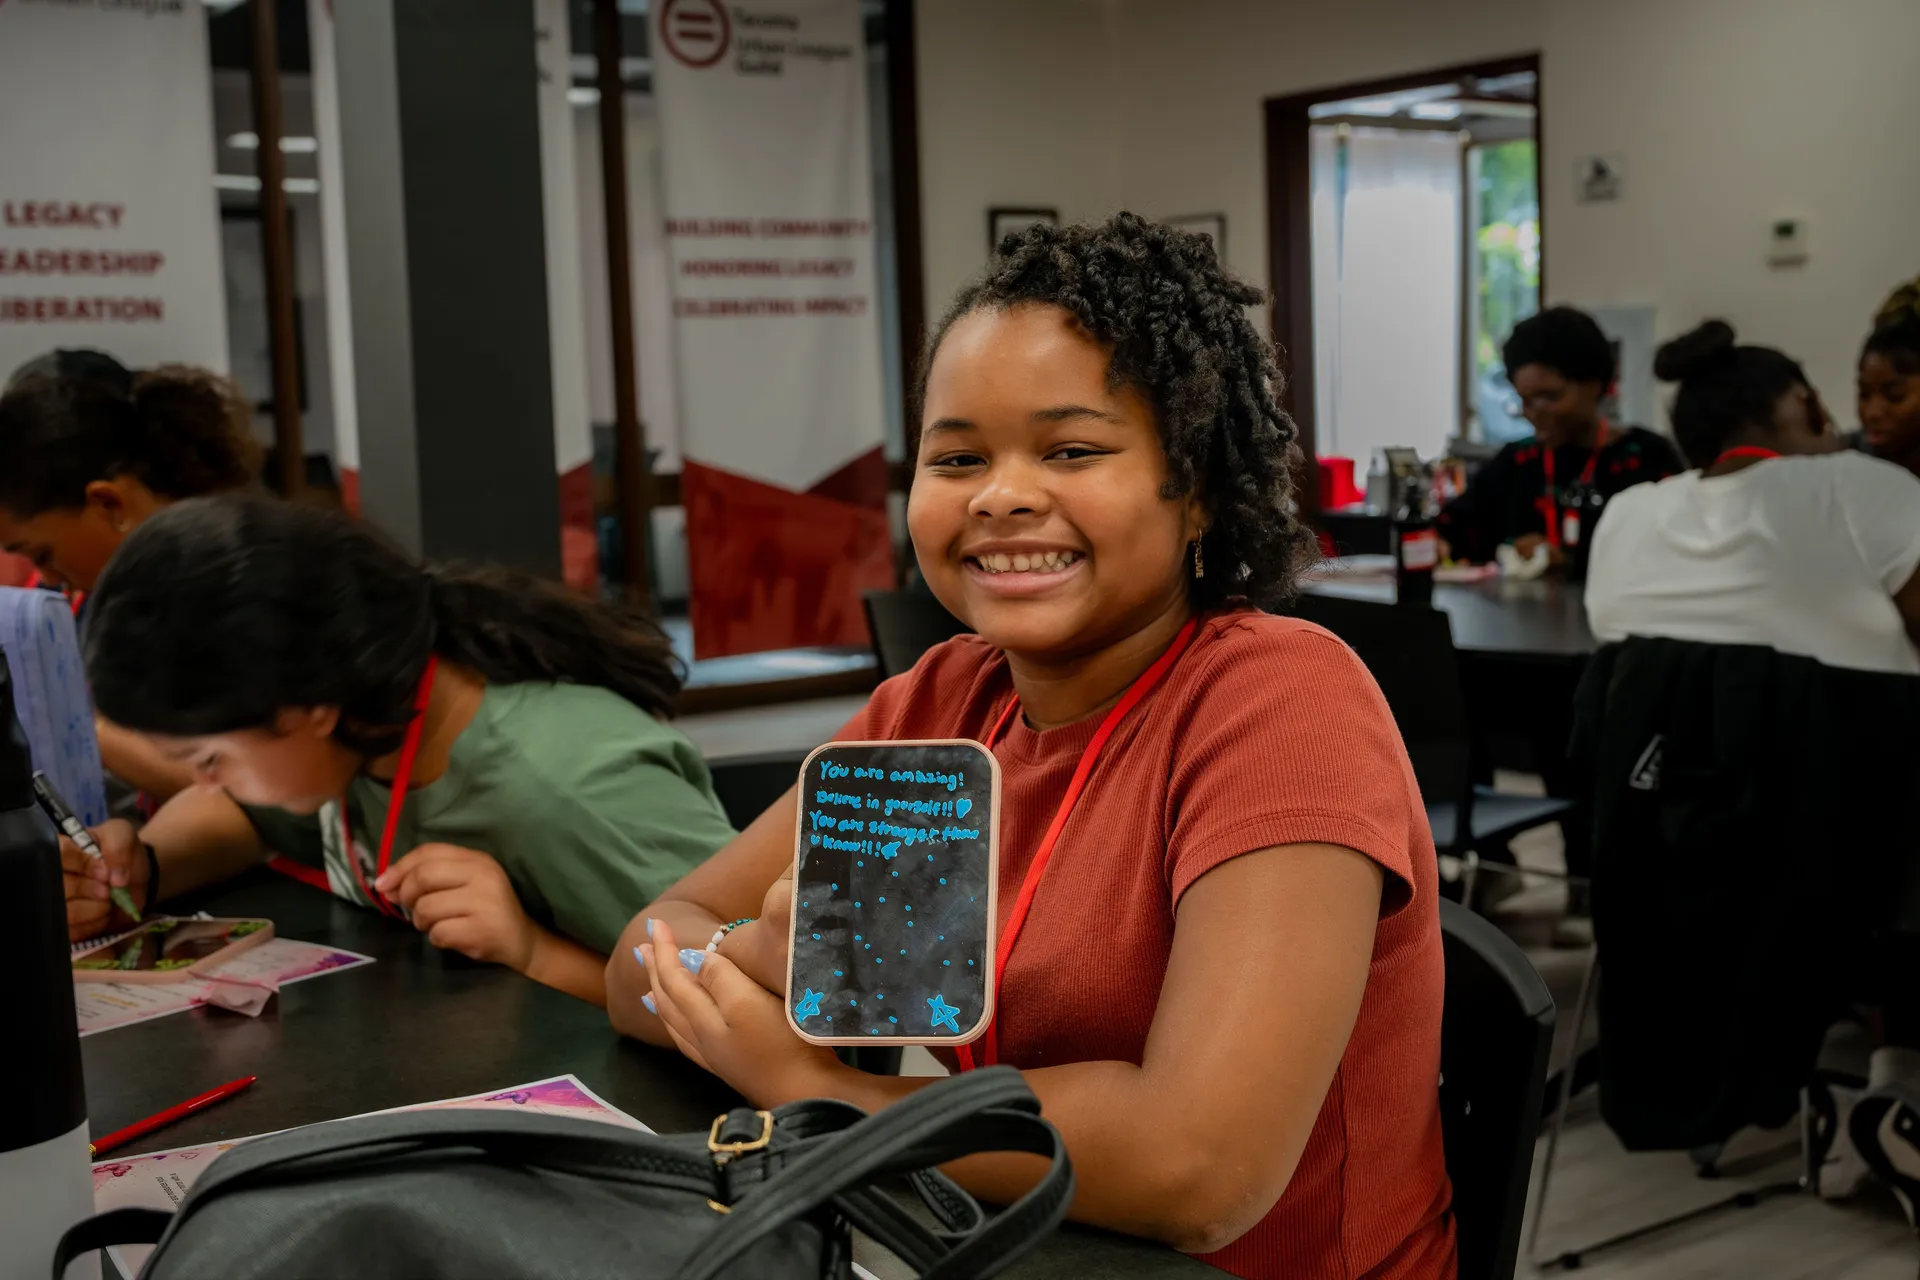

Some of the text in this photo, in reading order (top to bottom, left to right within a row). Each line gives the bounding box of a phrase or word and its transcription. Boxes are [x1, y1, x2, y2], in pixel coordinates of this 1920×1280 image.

[4, 201, 125, 228] LEGACY
[665, 219, 869, 238] BUILDING COMMUNITY
[681, 258, 855, 277] HONORING LEGACY
[673, 297, 868, 317] CELEBRATING IMPACT
[820, 760, 964, 792] You are amazing!
[866, 793, 880, 809] in
[809, 809, 837, 831] You
[837, 818, 864, 832] are
[942, 826, 980, 842] than
